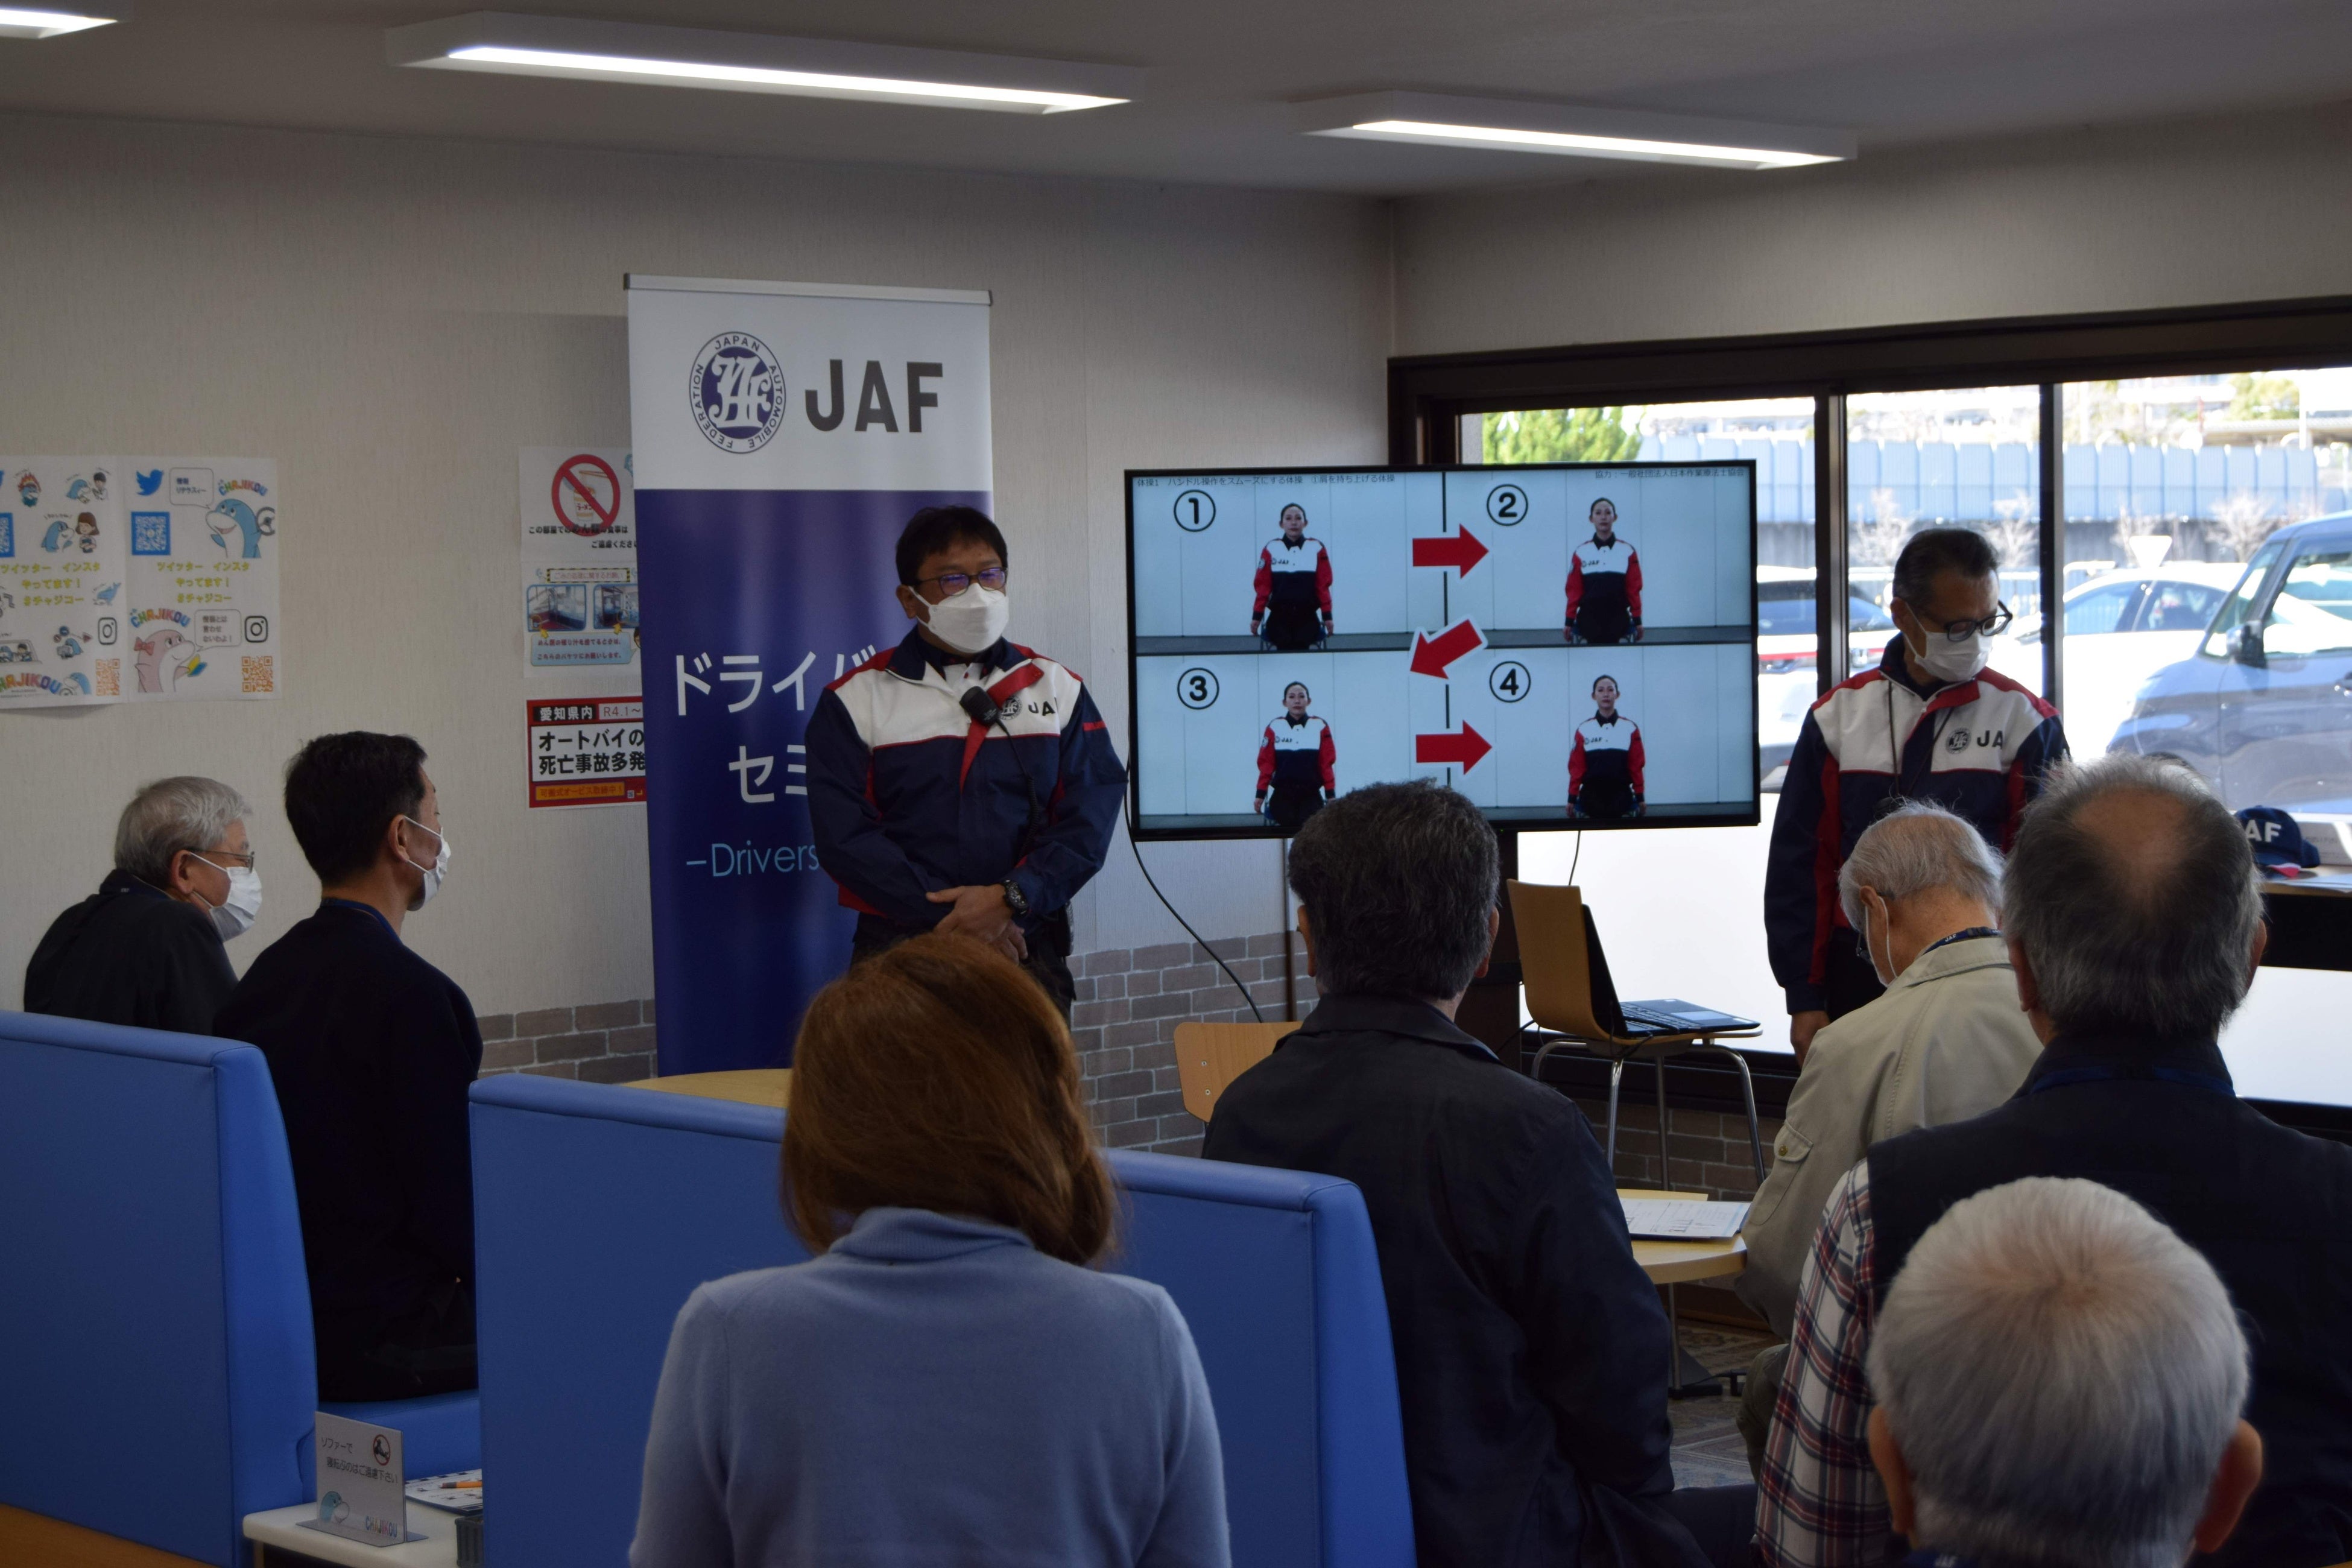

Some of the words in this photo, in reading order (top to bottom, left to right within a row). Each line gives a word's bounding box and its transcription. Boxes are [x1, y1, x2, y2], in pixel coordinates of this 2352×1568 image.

[714, 335, 760, 352] JAPAN
[805, 359, 943, 433] JAF
[692, 364, 734, 449] FEDERATION
[747, 364, 782, 449] AUTOMOBILE
[218, 479, 268, 497] CHAJIKOU
[0, 563, 52, 574] ツイッター
[62, 561, 101, 572] インスタ
[157, 561, 203, 572] ツイッター
[213, 561, 250, 572] インスタ
[130, 608, 191, 628] CHAJIKOU
[540, 706, 593, 722] 愛知県内
[1028, 697, 1059, 716] JA
[539, 728, 644, 752] オートバイの
[539, 751, 645, 776] 死亡事故多発
[320, 1436, 353, 1454] ソファーで
[365, 1515, 398, 1538] CHAJIKOU
